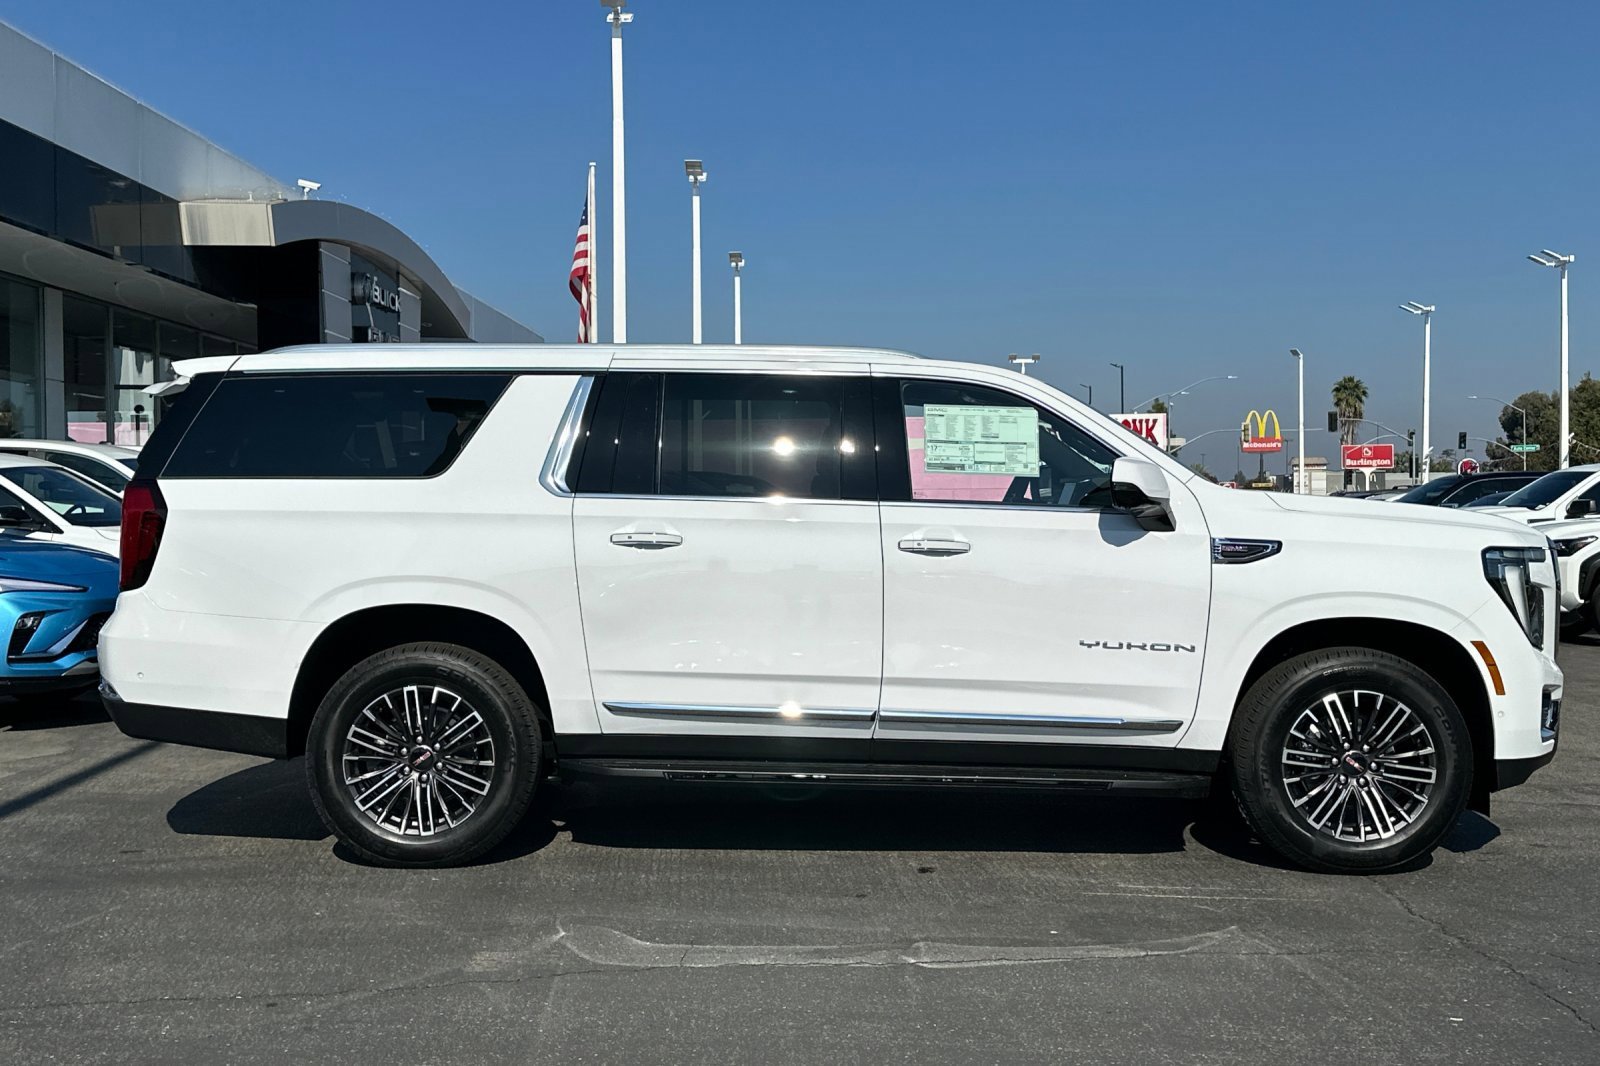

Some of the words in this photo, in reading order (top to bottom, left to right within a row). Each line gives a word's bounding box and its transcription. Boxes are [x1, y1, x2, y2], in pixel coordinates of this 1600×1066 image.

[373, 285, 401, 312] BUICK
[1345, 458, 1391, 467] Burlington
[1079, 640, 1195, 653] YUKON
